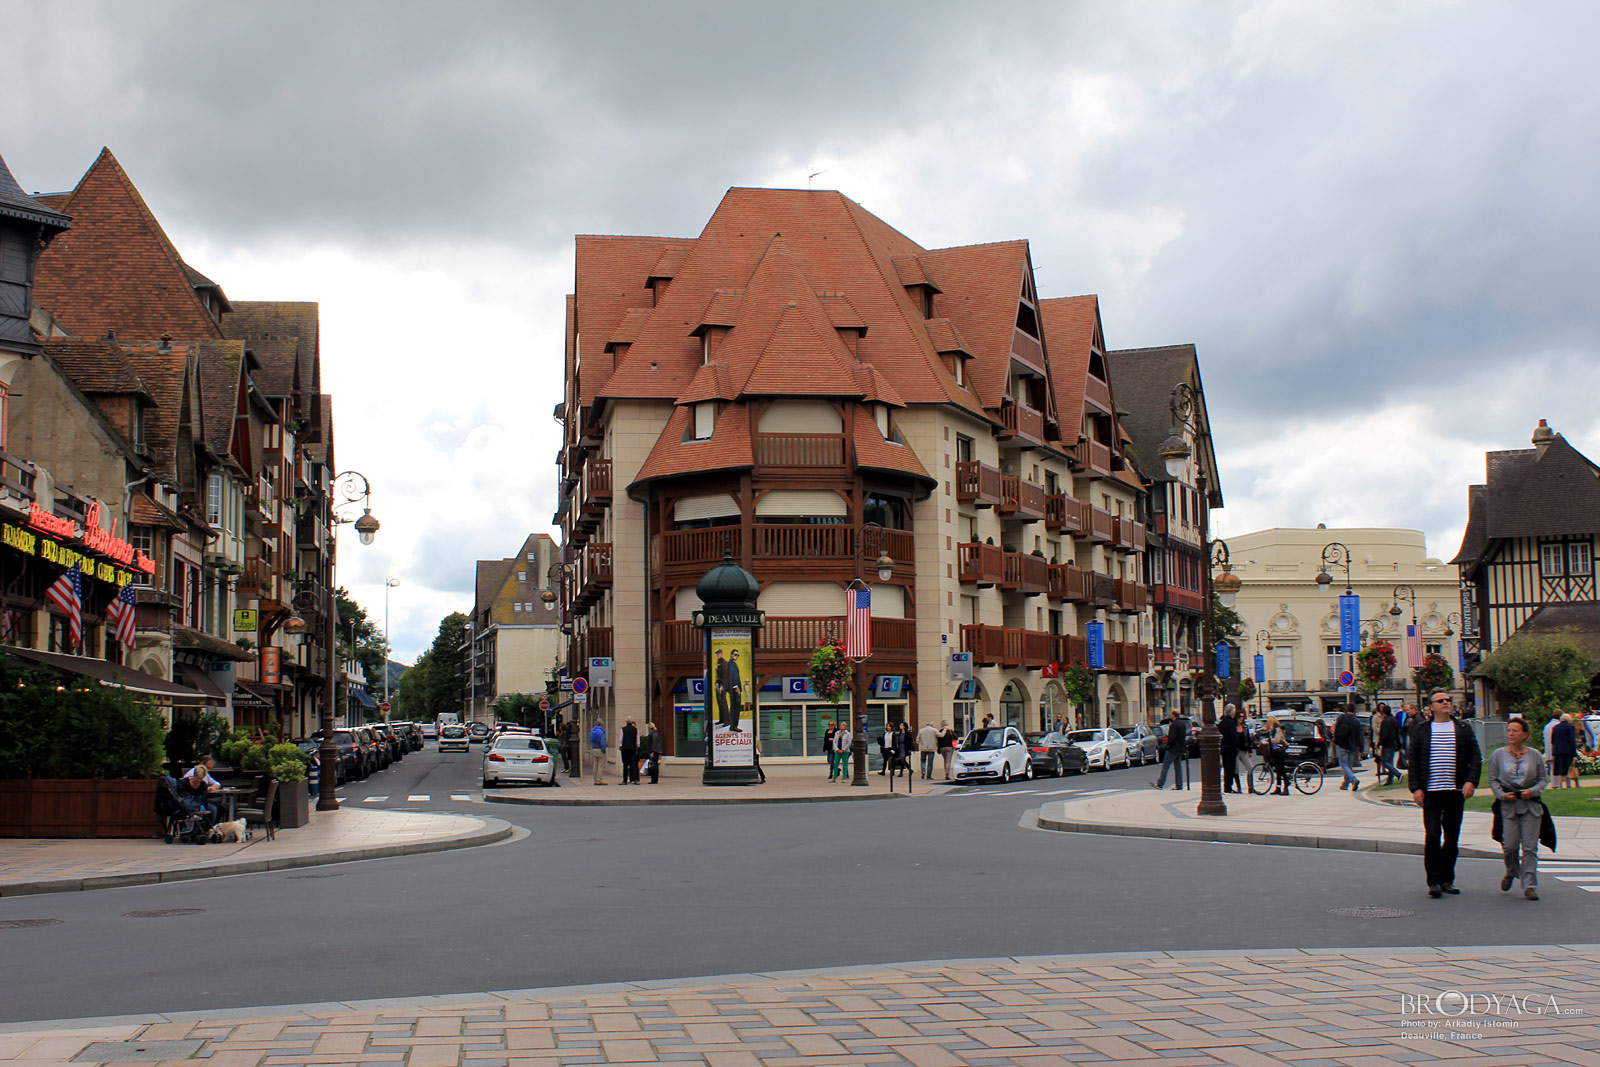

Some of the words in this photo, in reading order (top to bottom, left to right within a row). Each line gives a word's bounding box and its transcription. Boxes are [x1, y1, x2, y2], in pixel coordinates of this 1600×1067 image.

[1463, 591, 1472, 635] PRINTEMPS
[708, 614, 759, 624] DEAUVILLE
[953, 653, 968, 661] CIC
[213, 663, 230, 671] CIC
[884, 680, 899, 690] CIC
